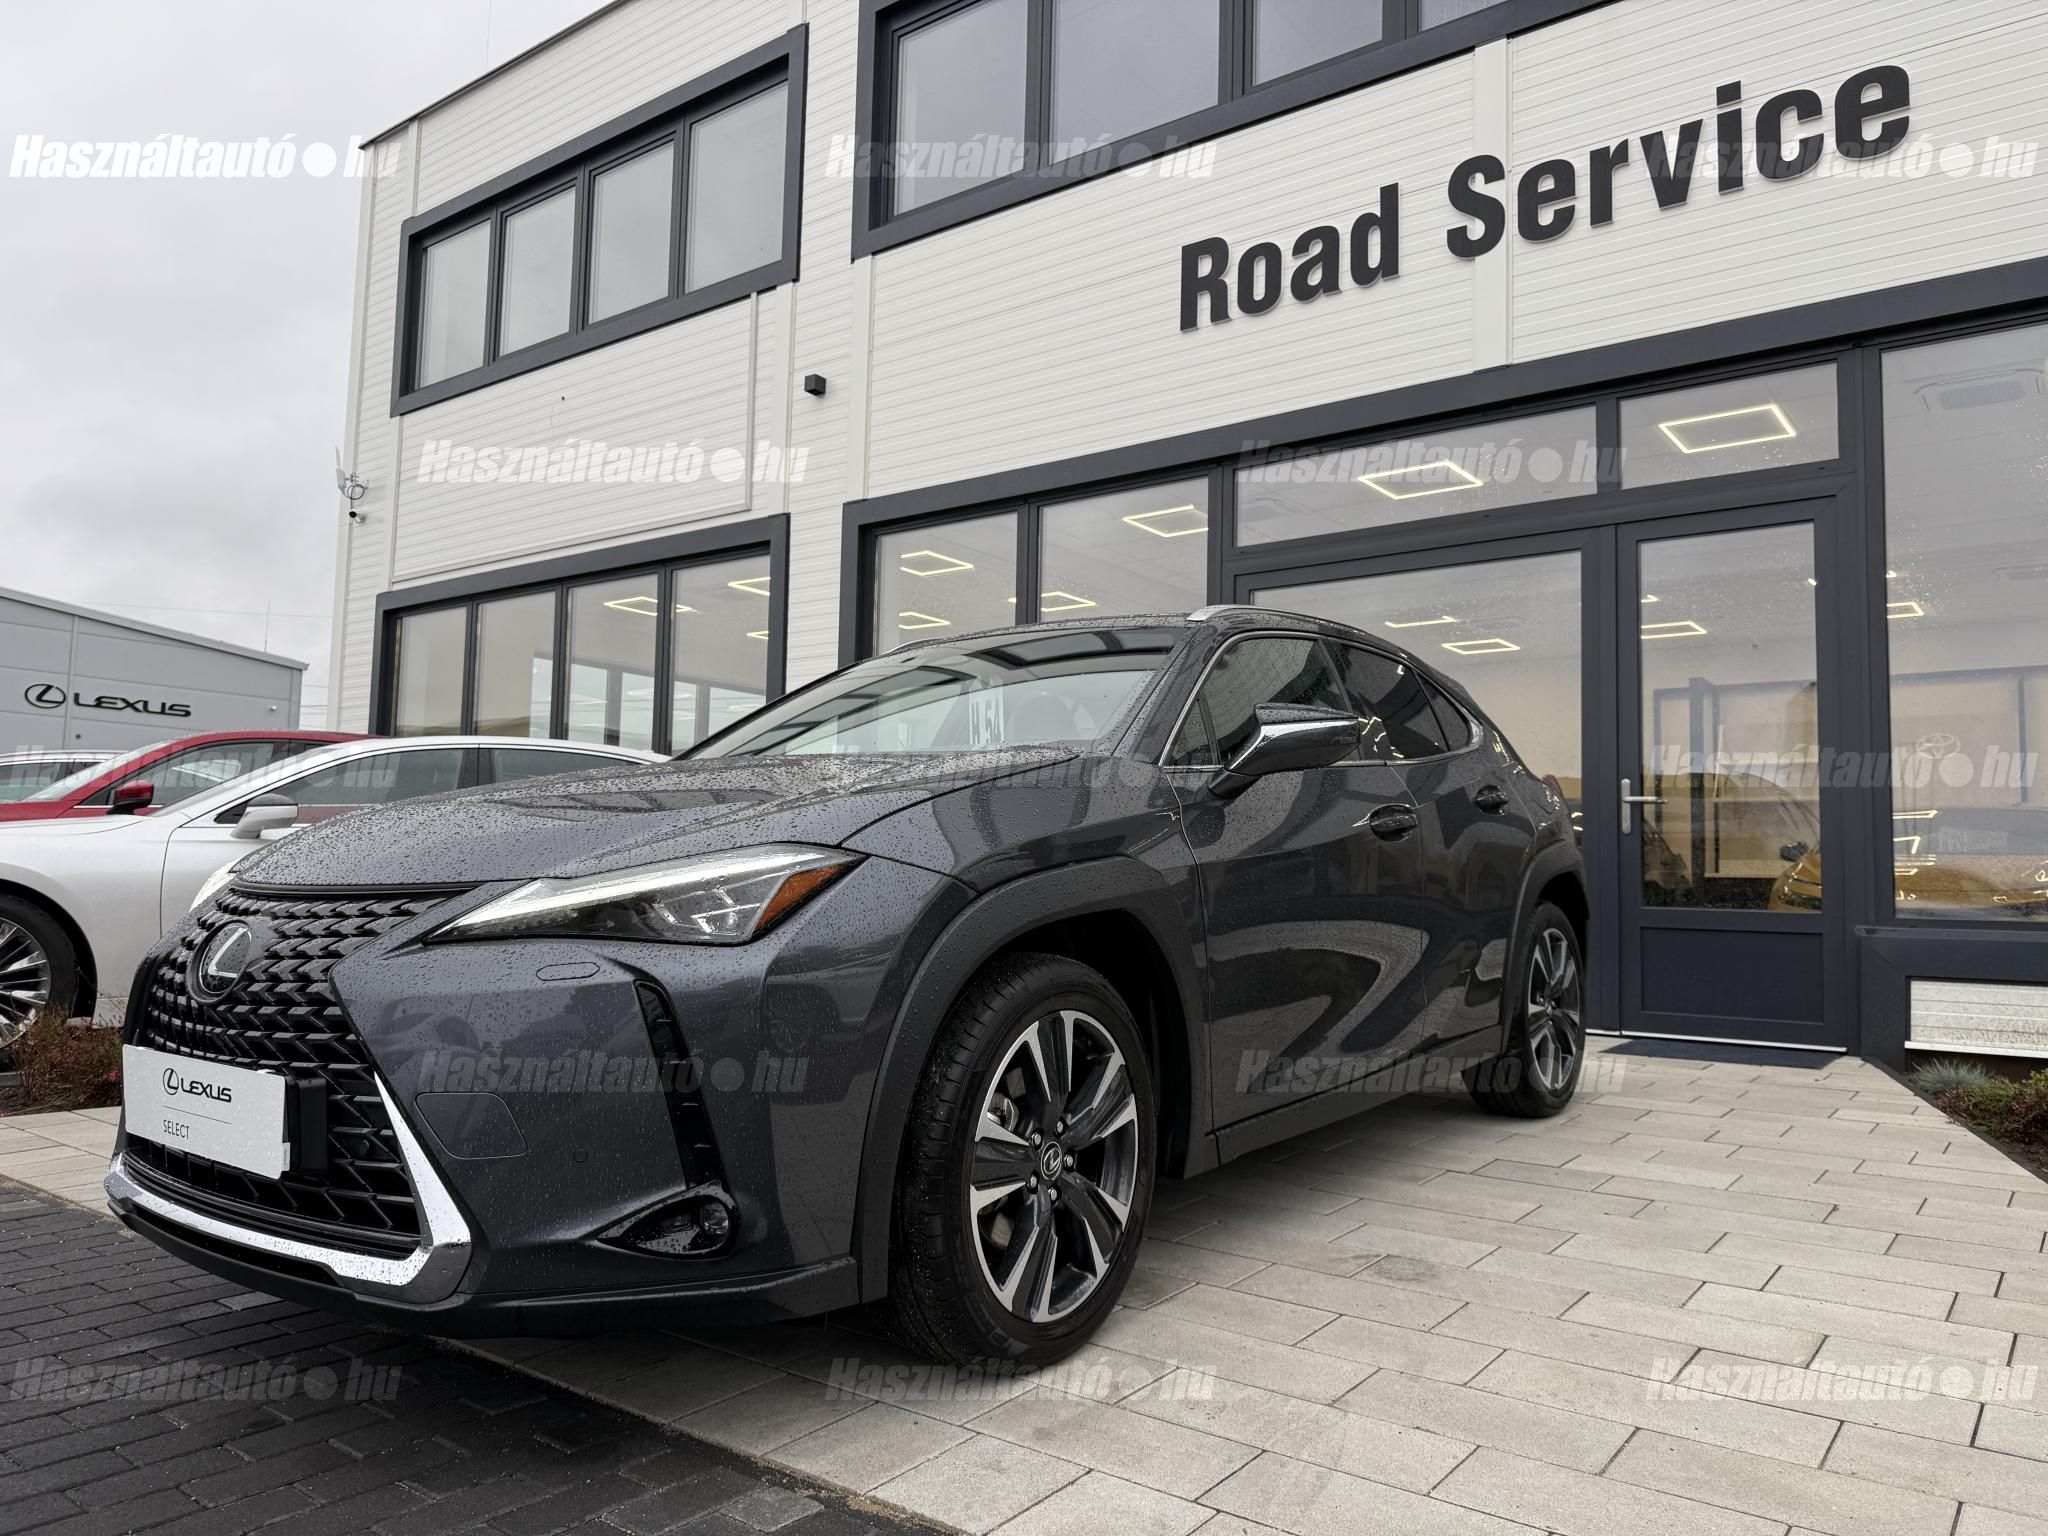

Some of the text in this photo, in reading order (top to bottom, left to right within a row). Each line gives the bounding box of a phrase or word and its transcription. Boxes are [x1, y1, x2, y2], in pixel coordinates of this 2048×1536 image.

[1180, 65, 1911, 332] Road Service
[74, 693, 191, 717] LEXUS
[181, 1078, 232, 1103] LEXUS
[163, 1119, 190, 1140] SELECT
